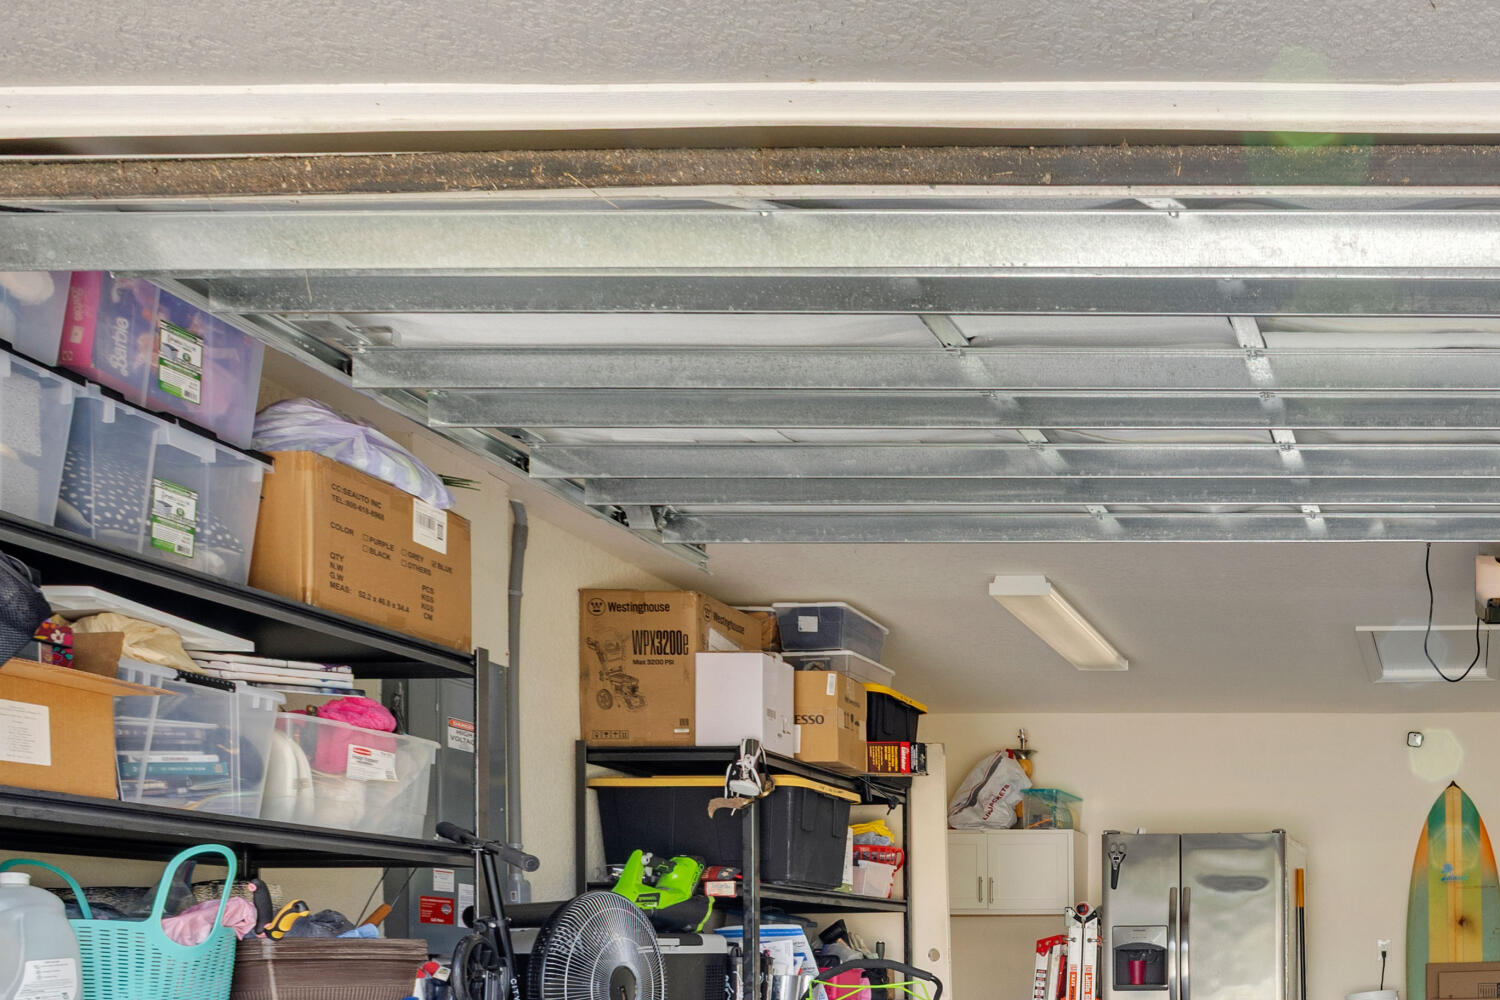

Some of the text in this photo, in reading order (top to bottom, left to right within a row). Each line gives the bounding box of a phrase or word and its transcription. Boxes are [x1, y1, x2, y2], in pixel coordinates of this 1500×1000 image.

[108, 317, 129, 377] Barbie
[330, 521, 354, 536] COLOR
[369, 536, 395, 551] PURPLE
[329, 552, 344, 562] QTY
[369, 547, 391, 561] BLACK
[608, 601, 670, 614] Westinghouse
[713, 613, 744, 635] Westinghouse
[632, 630, 689, 656] WPX3200e
